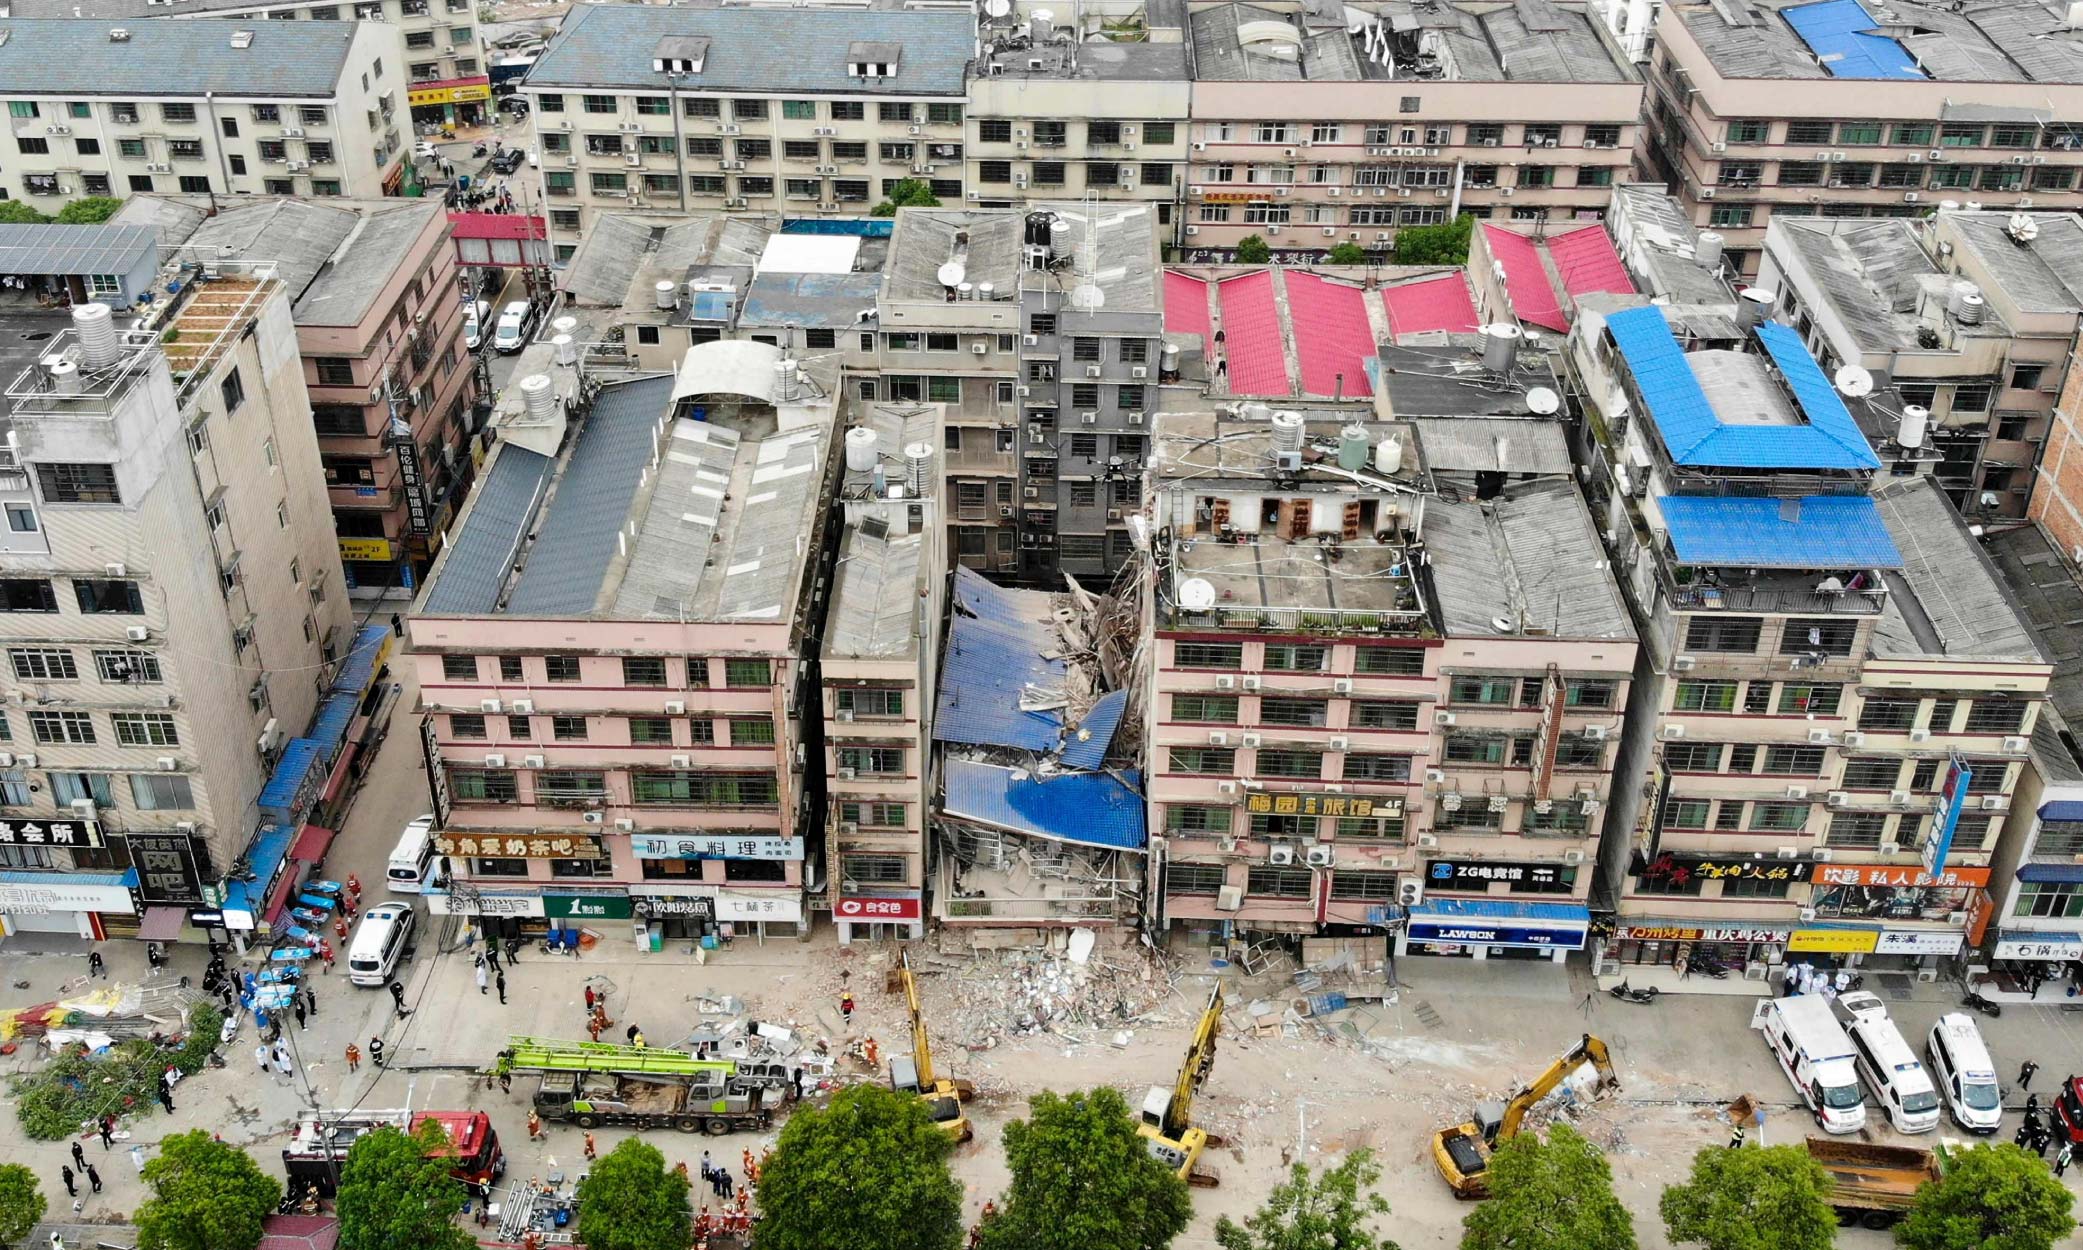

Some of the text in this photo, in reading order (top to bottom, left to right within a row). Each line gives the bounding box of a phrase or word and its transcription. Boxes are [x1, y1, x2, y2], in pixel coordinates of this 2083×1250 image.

[1384, 800, 1402, 809] 4F
[646, 840, 757, 856] 初食料理
[142, 851, 190, 892] 网吧
[1457, 866, 1523, 880] ZG电竞馆
[1439, 929, 1495, 940] LAWSON
